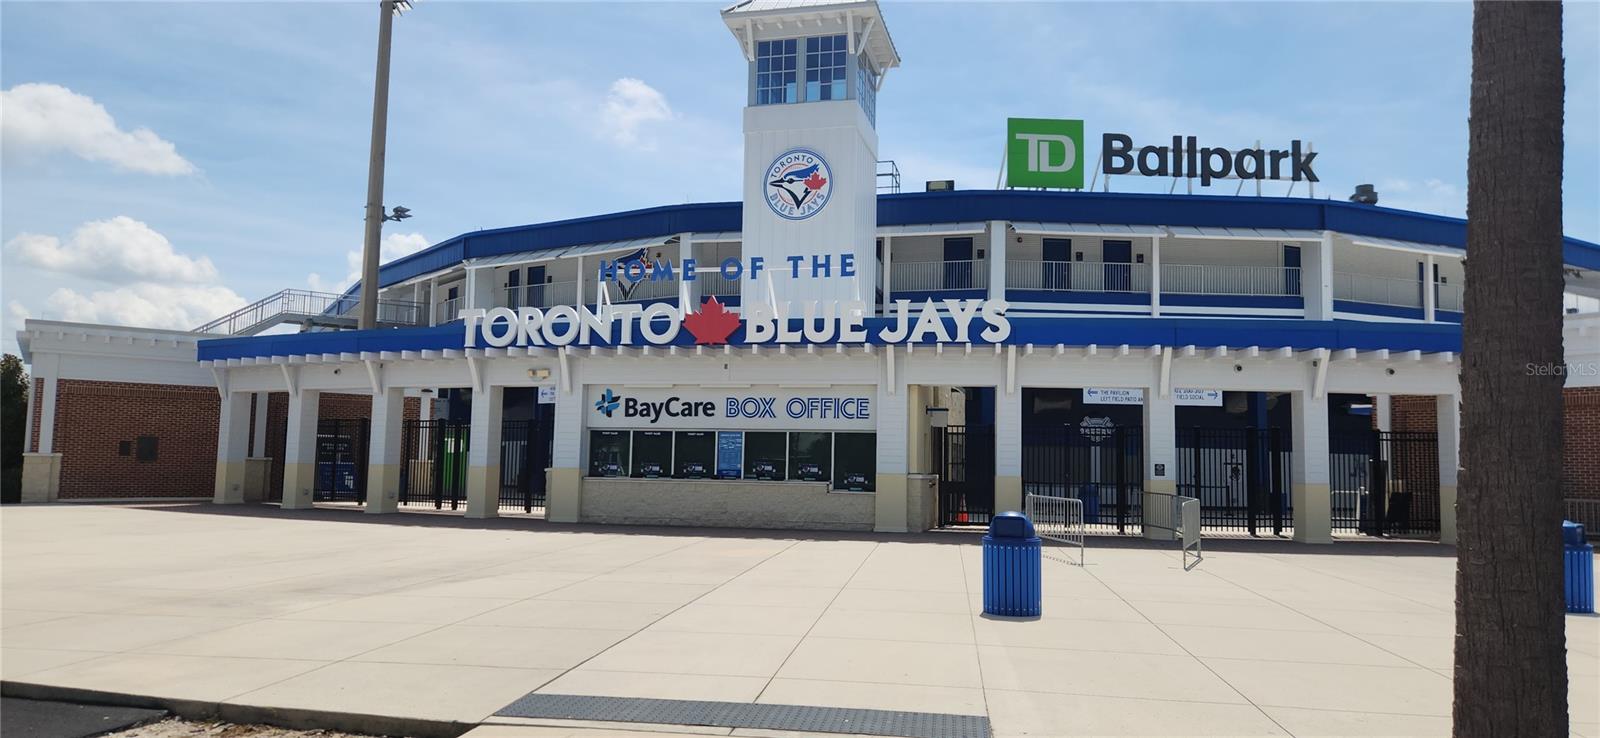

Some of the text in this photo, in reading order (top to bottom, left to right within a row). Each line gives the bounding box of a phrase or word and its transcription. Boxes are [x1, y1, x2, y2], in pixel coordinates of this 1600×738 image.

[771, 154, 814, 178] TORONTO
[1016, 132, 1320, 187] TD Ballpark
[769, 192, 825, 216] BLUE JAYS
[599, 253, 856, 283] HOME OF THE
[458, 296, 1012, 348] TORONTO BLUE JAYS
[624, 396, 870, 424] BayCare BOX OFFICE
